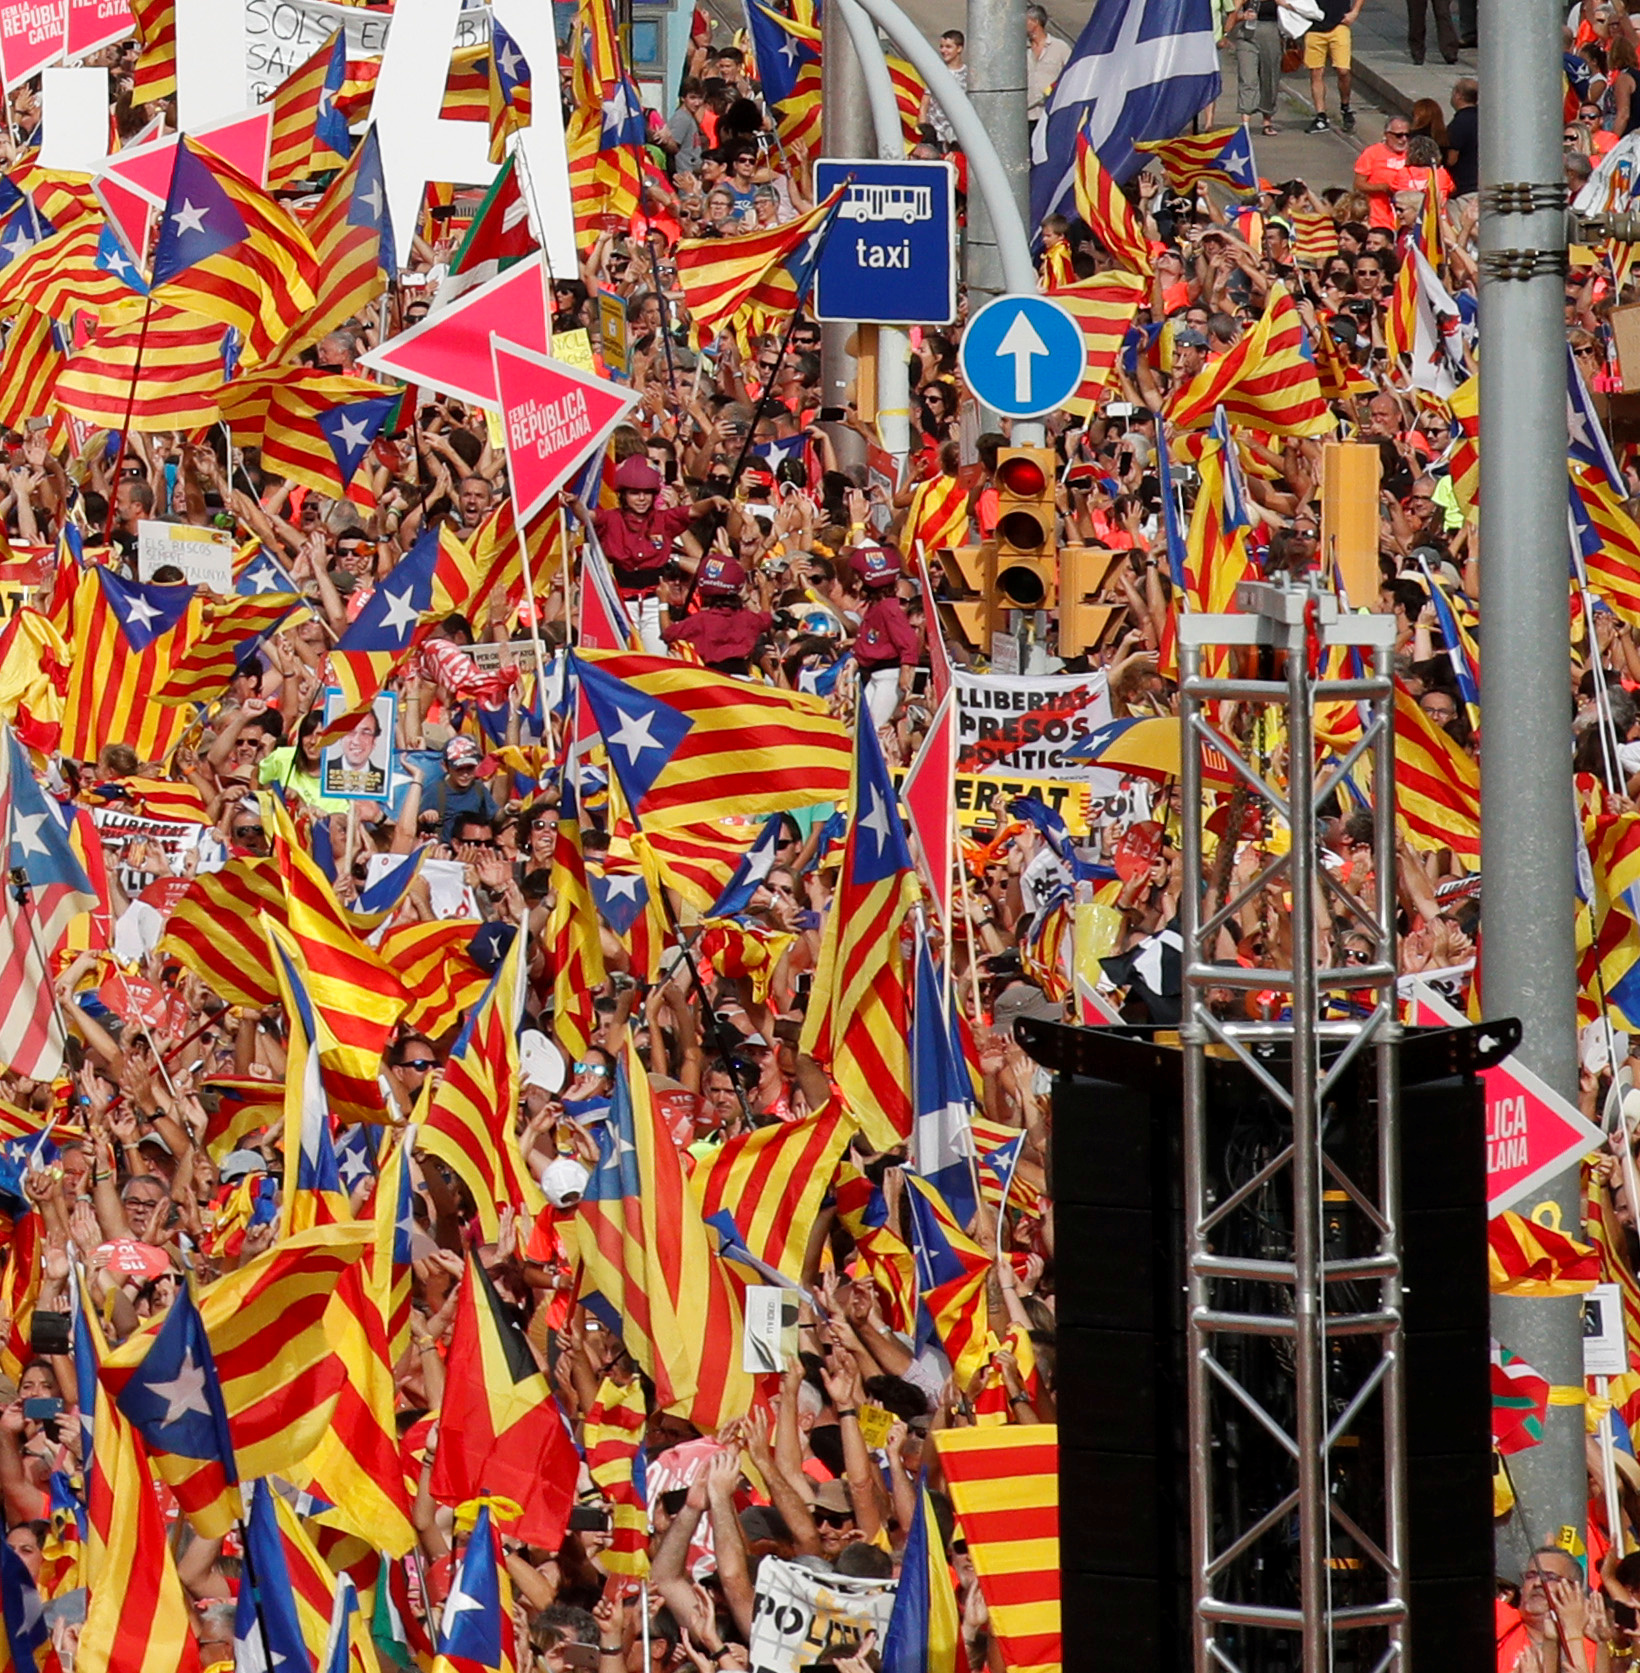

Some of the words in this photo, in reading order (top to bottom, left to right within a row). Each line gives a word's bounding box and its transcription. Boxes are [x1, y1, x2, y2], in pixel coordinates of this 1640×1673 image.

[1, 4, 18, 19] FEM
[18, 1, 30, 15] LA
[856, 238, 910, 269] taxi
[507, 403, 526, 424] FEM
[525, 398, 537, 417] LA
[510, 387, 587, 450] REPÚBLICA
[537, 414, 592, 459] CATALANA
[956, 684, 1090, 711] LLIBERTAT
[959, 714, 1092, 744] PRESOS
[102, 812, 191, 837] LLIBERTAT
